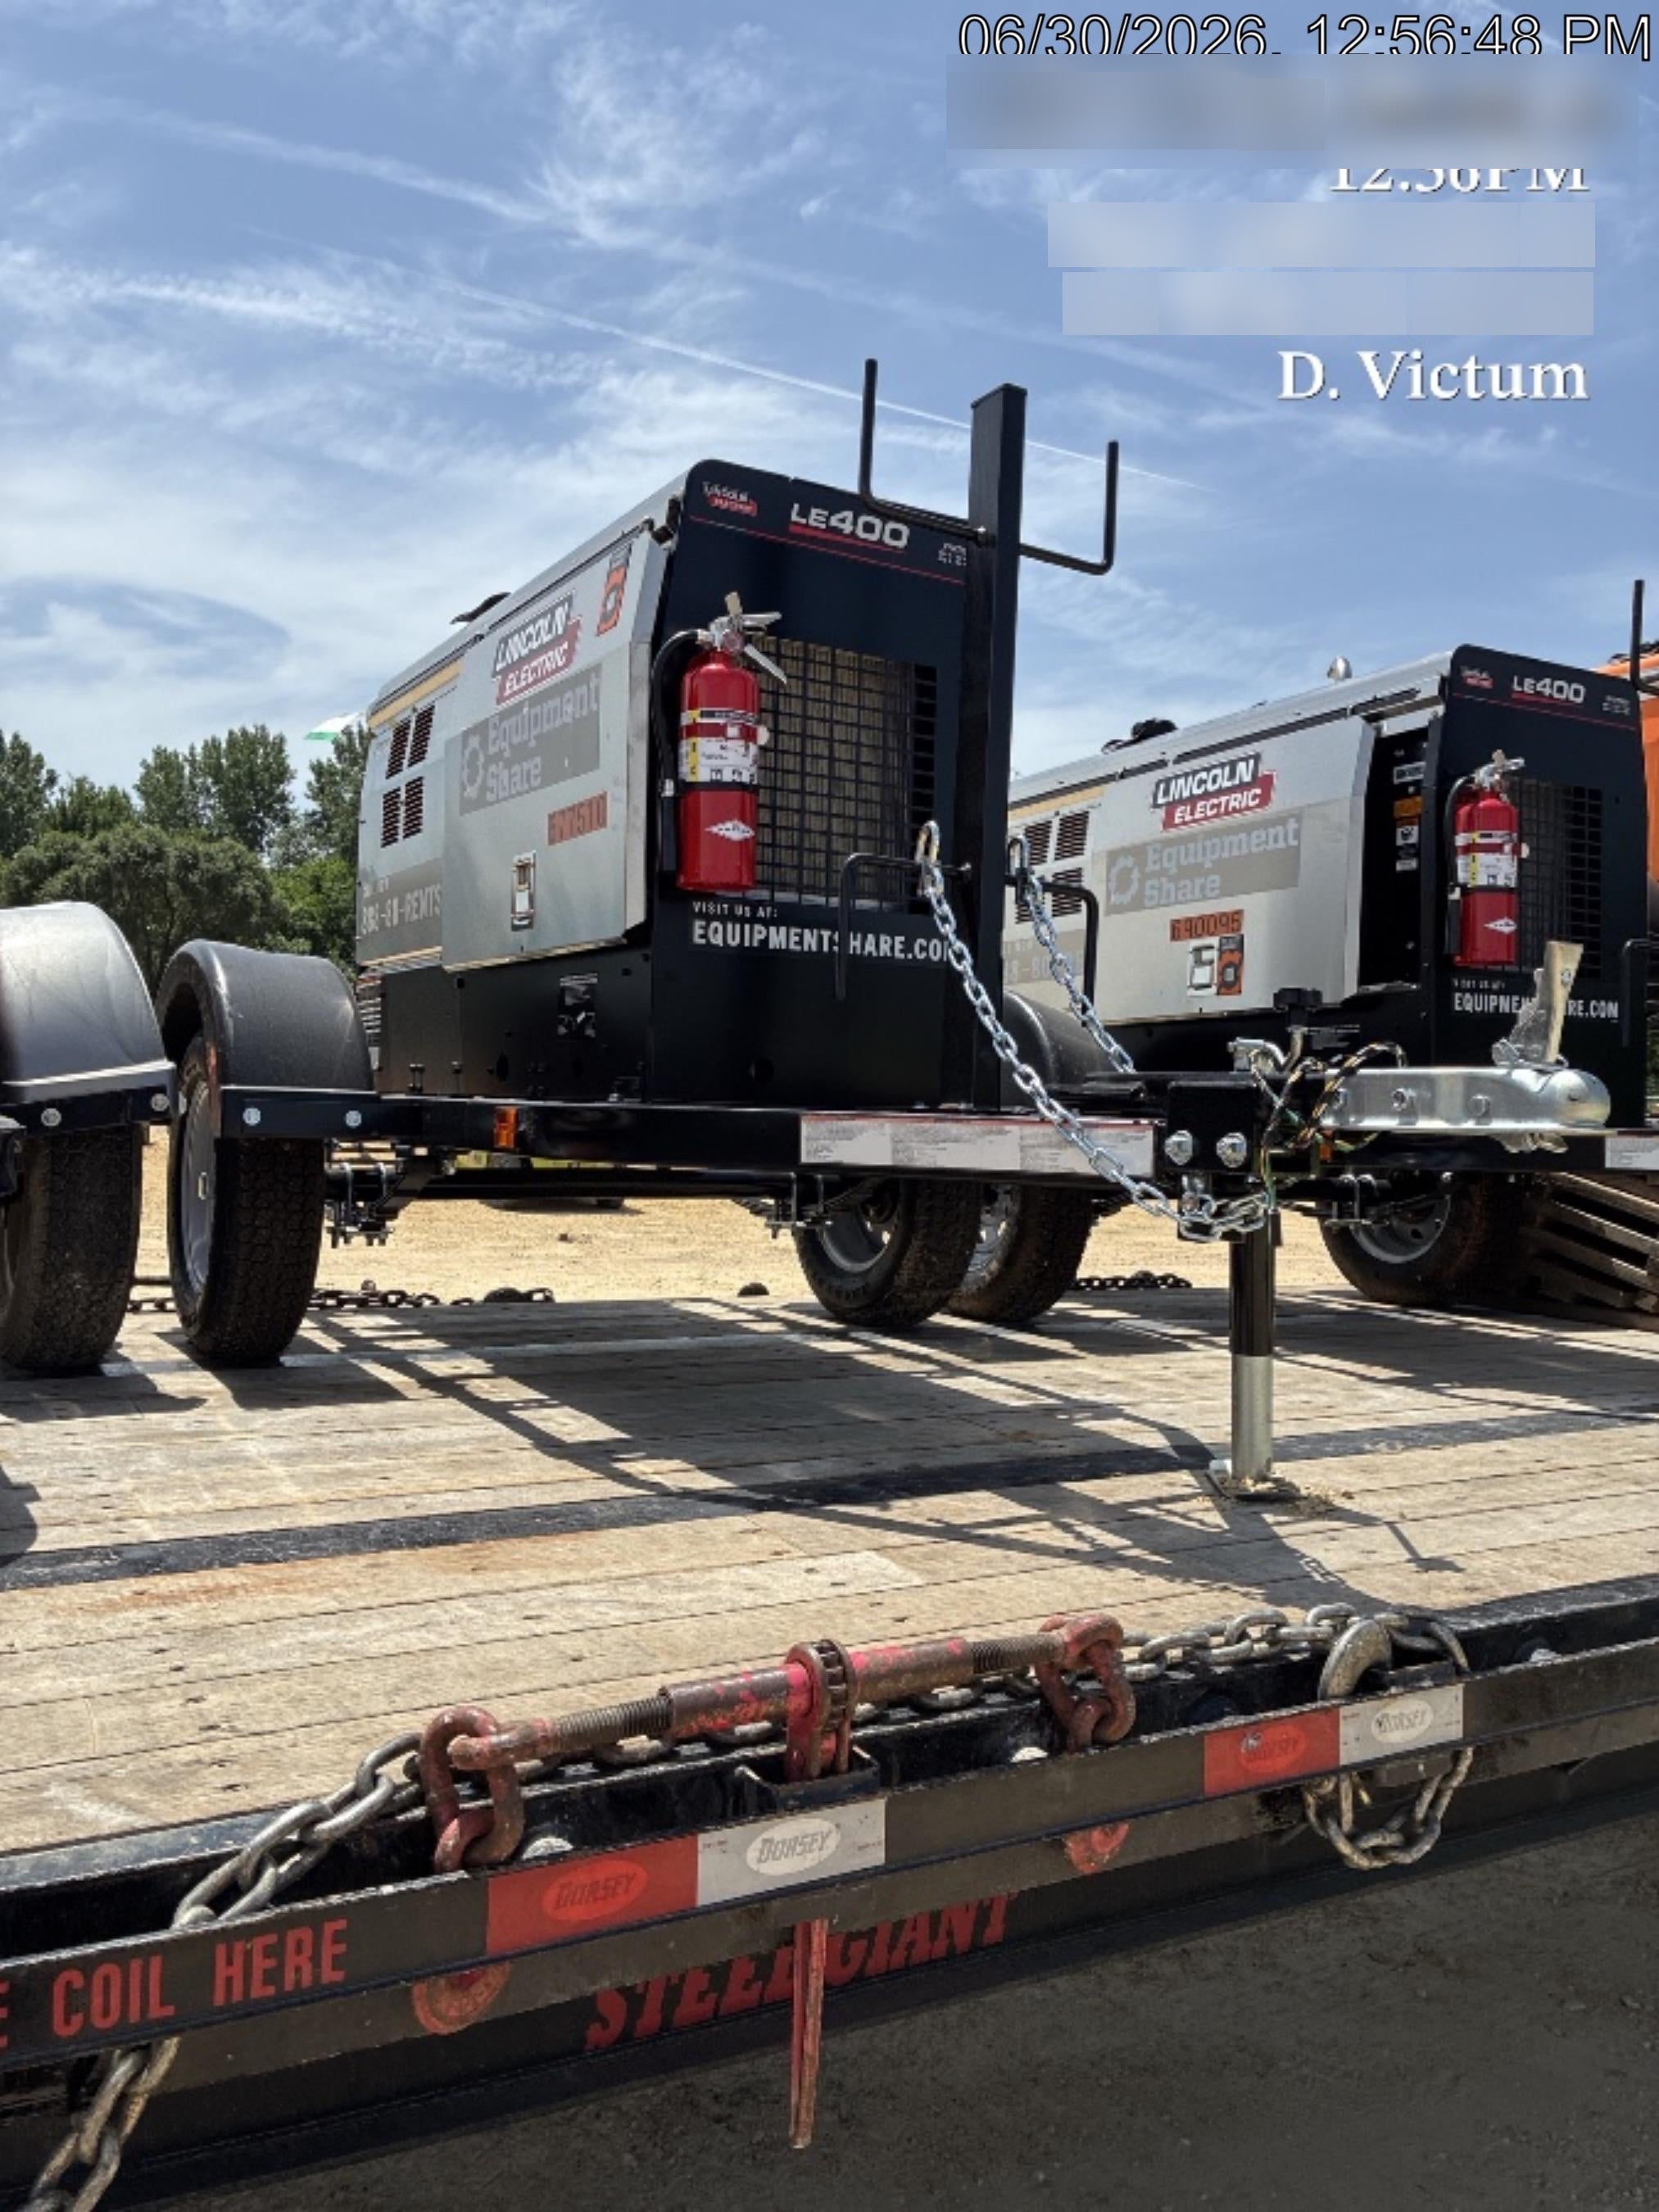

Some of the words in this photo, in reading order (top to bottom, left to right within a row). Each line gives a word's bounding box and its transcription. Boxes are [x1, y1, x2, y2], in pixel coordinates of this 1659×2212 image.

[790, 501, 910, 549] LE400
[496, 602, 569, 672] LINCOLN
[503, 640, 569, 696] ELECTRIC
[1512, 674, 1586, 704] LE400
[488, 672, 601, 758] Equipment
[486, 755, 542, 802] Share
[1156, 758, 1255, 805] LINCOLN
[1173, 787, 1262, 824] ELECTRIC
[1145, 818, 1299, 874] Equipment
[693, 901, 728, 917] VISIT
[734, 904, 751, 918] US
[756, 905, 778, 918] AT:
[1144, 874, 1221, 907] Share
[756, 1829, 832, 1864] DORSEY
[555, 1872, 636, 1908] DORSEY
[52, 1955, 175, 2039] COIL
[213, 1918, 349, 2007] HERE
